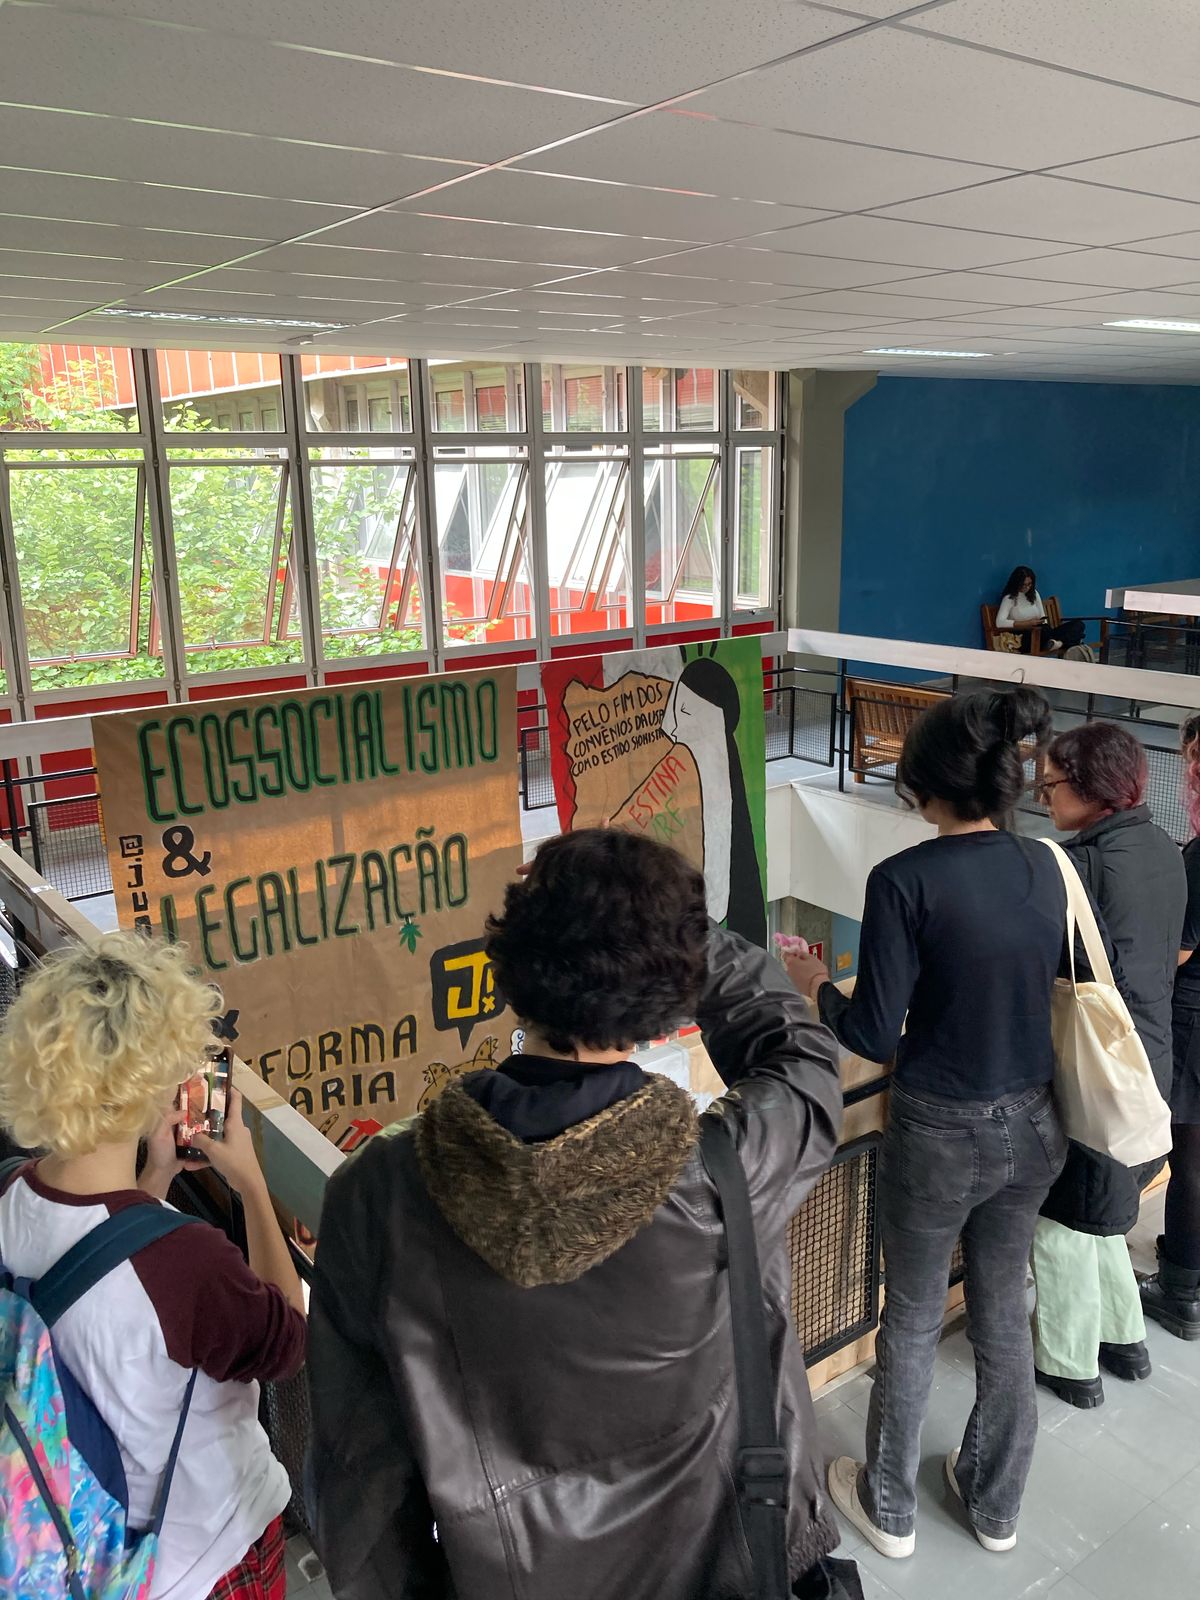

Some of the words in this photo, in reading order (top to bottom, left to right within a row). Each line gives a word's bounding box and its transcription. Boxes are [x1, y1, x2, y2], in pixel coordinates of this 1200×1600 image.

[573, 703, 610, 736] PELO
[613, 691, 634, 717] FIM
[637, 683, 662, 708] DOS
[574, 718, 632, 758] CONVÊNIOS
[635, 713, 648, 730] DA
[138, 679, 497, 823] ECOSSOCIALISMO
[162, 825, 211, 878] &
[245, 1014, 417, 1084] FORMA
